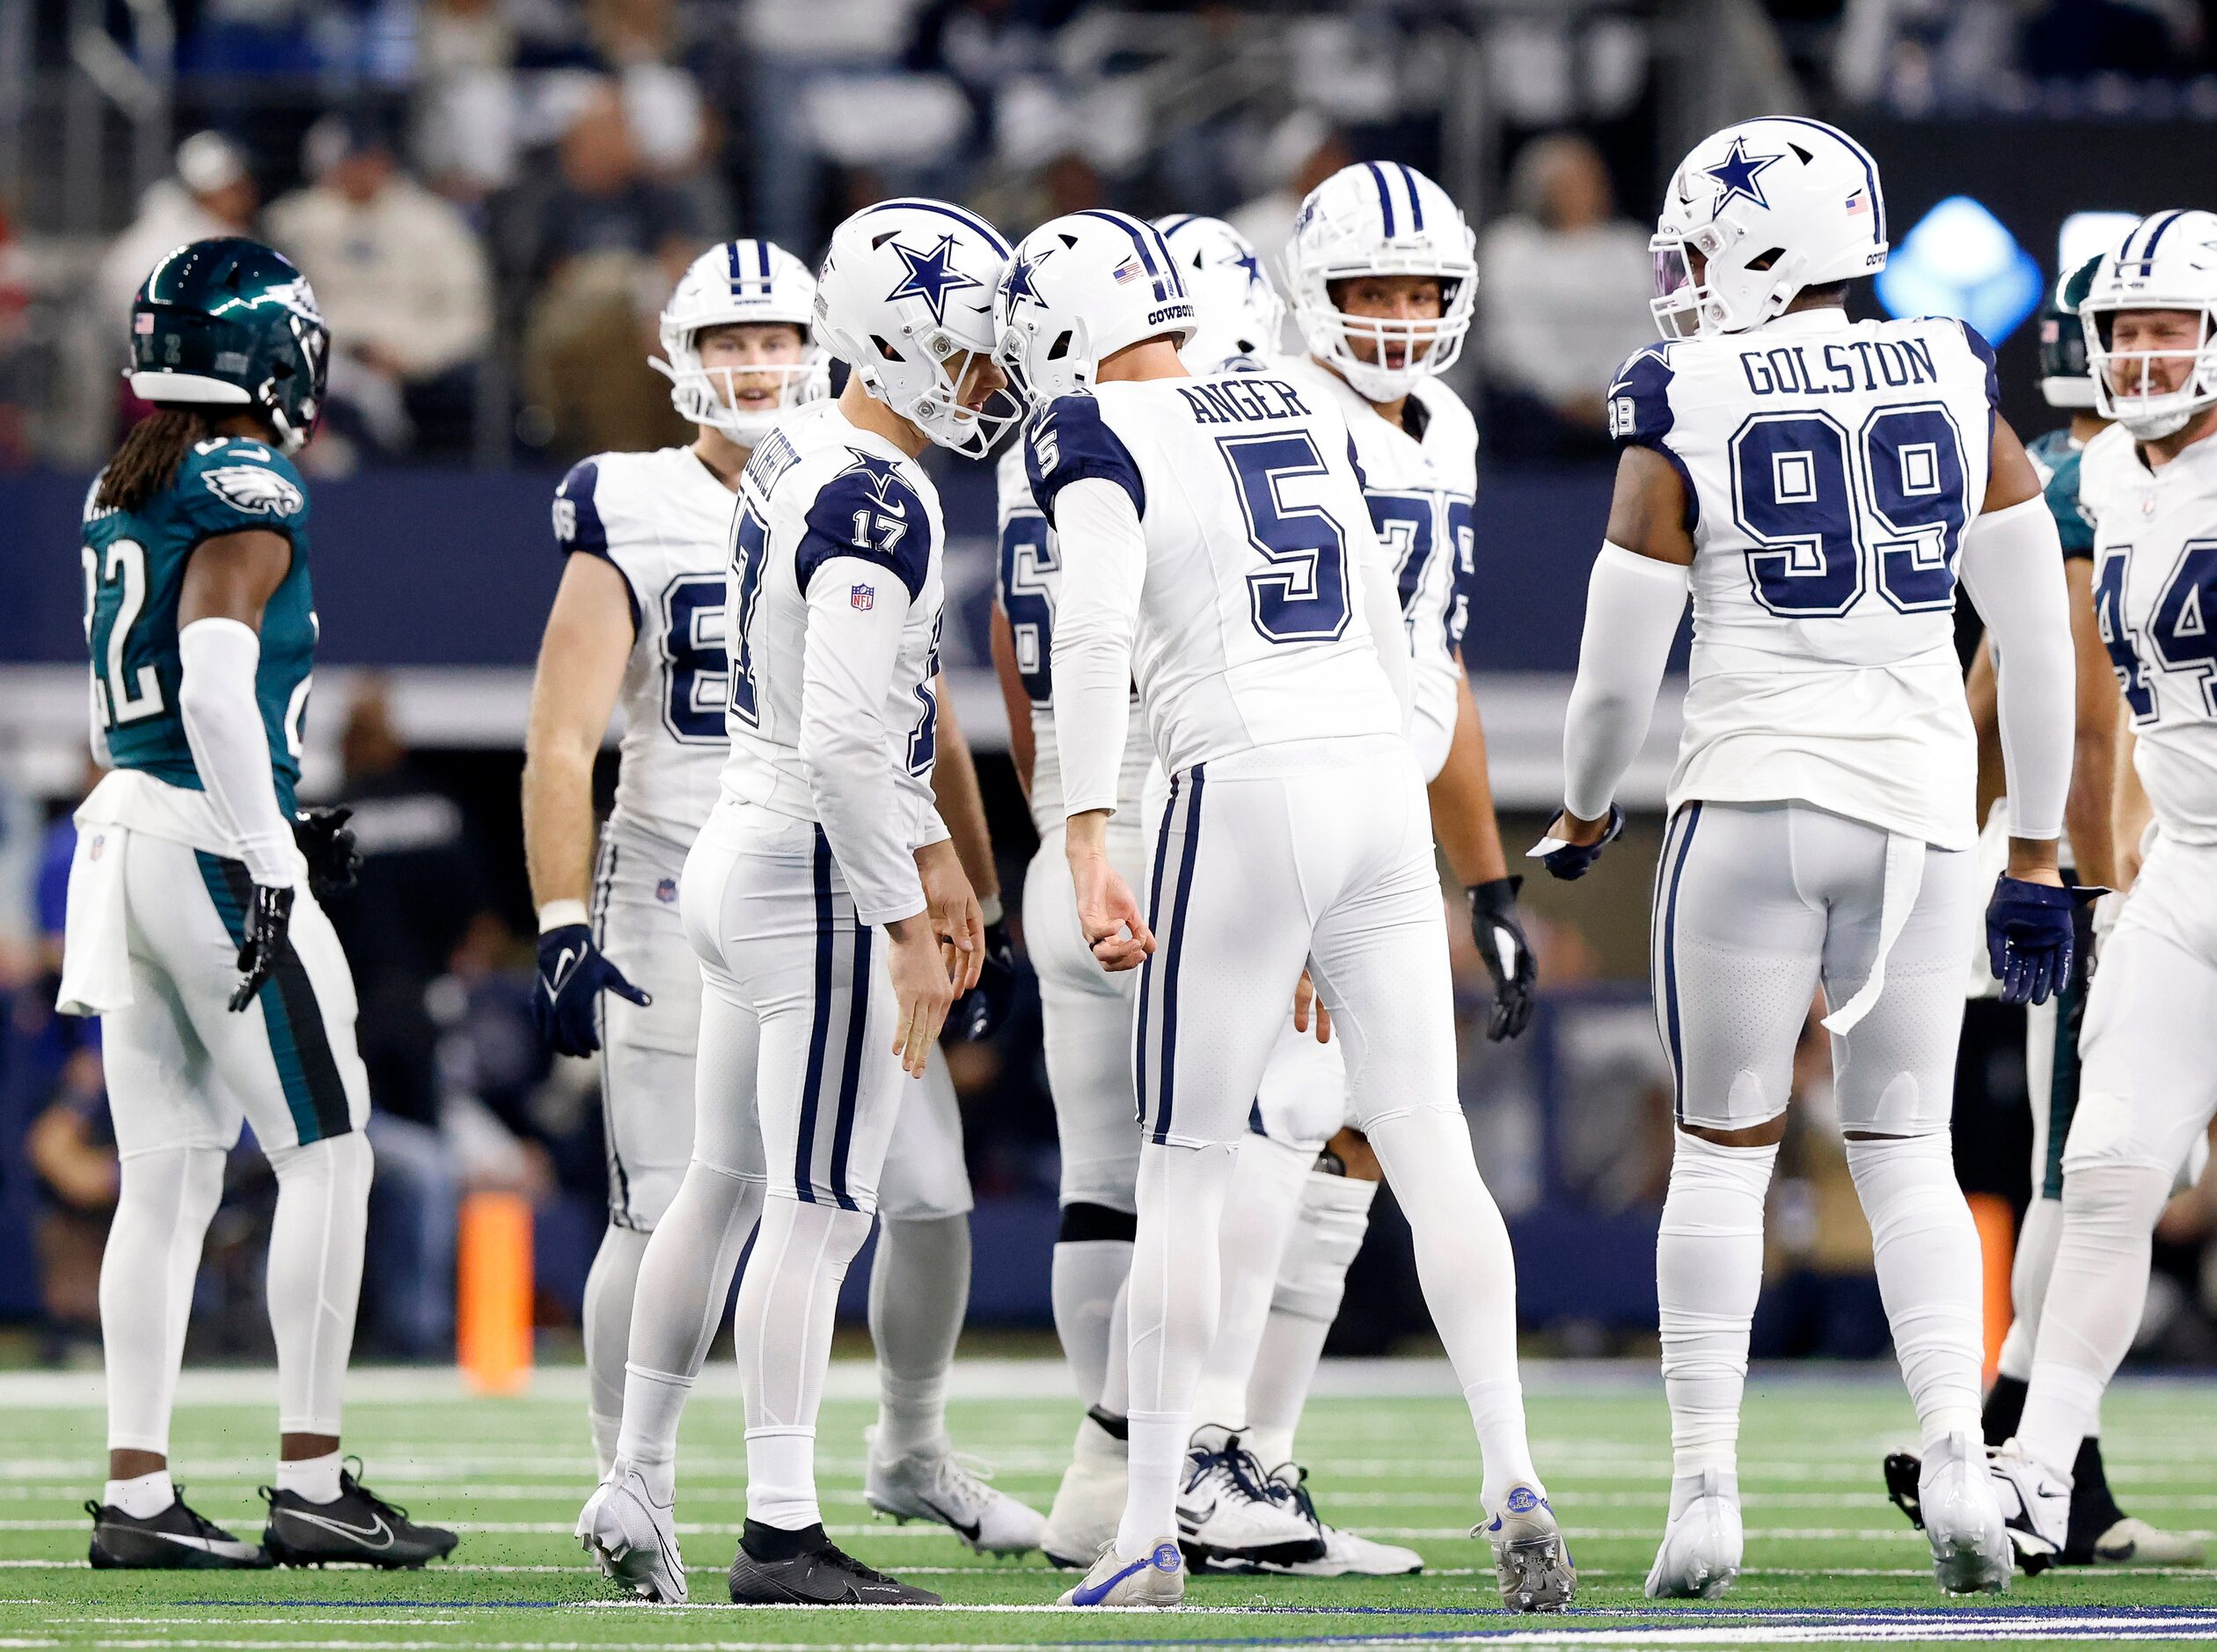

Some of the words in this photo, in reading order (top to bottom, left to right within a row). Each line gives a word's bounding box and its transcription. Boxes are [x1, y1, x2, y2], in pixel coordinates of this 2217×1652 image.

[1739, 338, 1937, 396] GOLSTON
[1176, 379, 1313, 424] ANGER
[1035, 429, 1060, 479] 5
[852, 509, 908, 555] 17
[1728, 399, 1971, 619] 99
[1214, 429, 1353, 645] 5
[853, 595, 872, 608] NFL
[2093, 538, 2217, 726] 44
